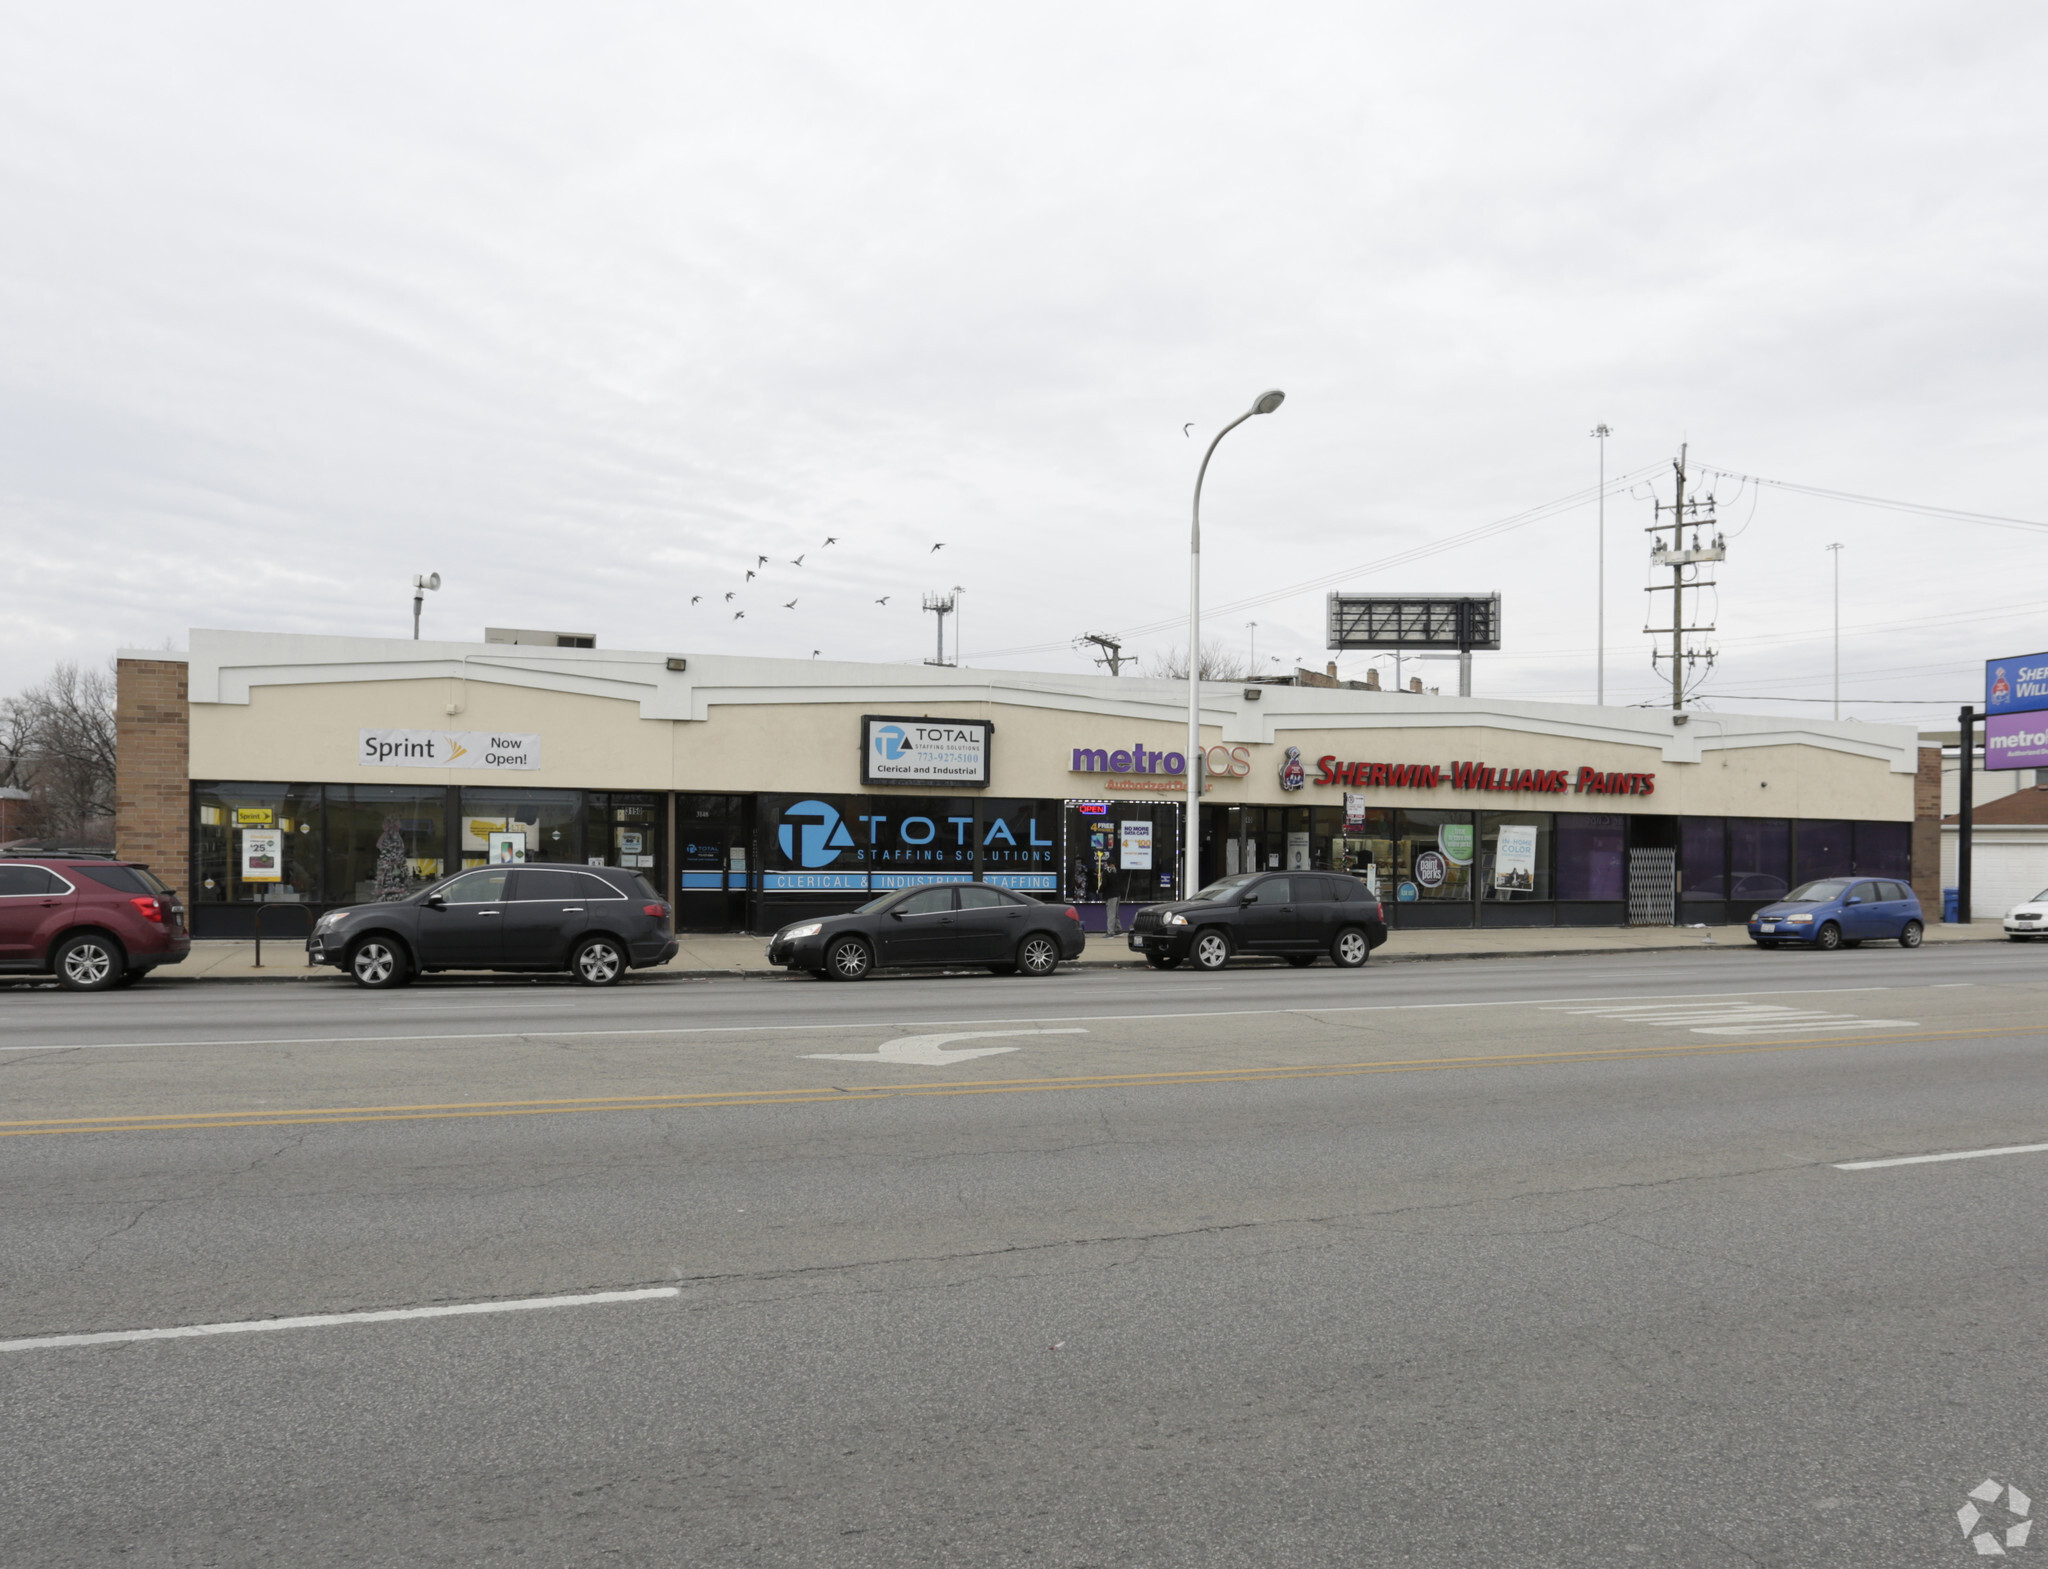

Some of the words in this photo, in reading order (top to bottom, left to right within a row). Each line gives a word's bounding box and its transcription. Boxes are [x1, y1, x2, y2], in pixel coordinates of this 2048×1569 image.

[916, 728, 980, 743] TOTAL
[365, 737, 435, 762] Sprint
[491, 737, 522, 749] Now
[485, 753, 527, 766] Open!
[1072, 743, 1250, 777] metroCS
[877, 765, 911, 773] Clerical
[913, 766, 930, 774] and
[933, 766, 977, 775] Industrial
[1314, 755, 1569, 793] SHERWIN-WILLIAMS
[1577, 766, 1655, 795] PAINTS
[1106, 779, 1172, 791] Authorized
[1080, 805, 1104, 813] OPEN
[859, 815, 1053, 846] TOTAL
[857, 849, 944, 861] STAFFING
[955, 850, 1051, 861] SOLUTIONS
[1502, 845, 1532, 853] COLOR
[1420, 858, 1438, 872] paint
[1422, 868, 1442, 881] perks
[777, 876, 851, 888] CLERICAL
[860, 876, 868, 888] &
